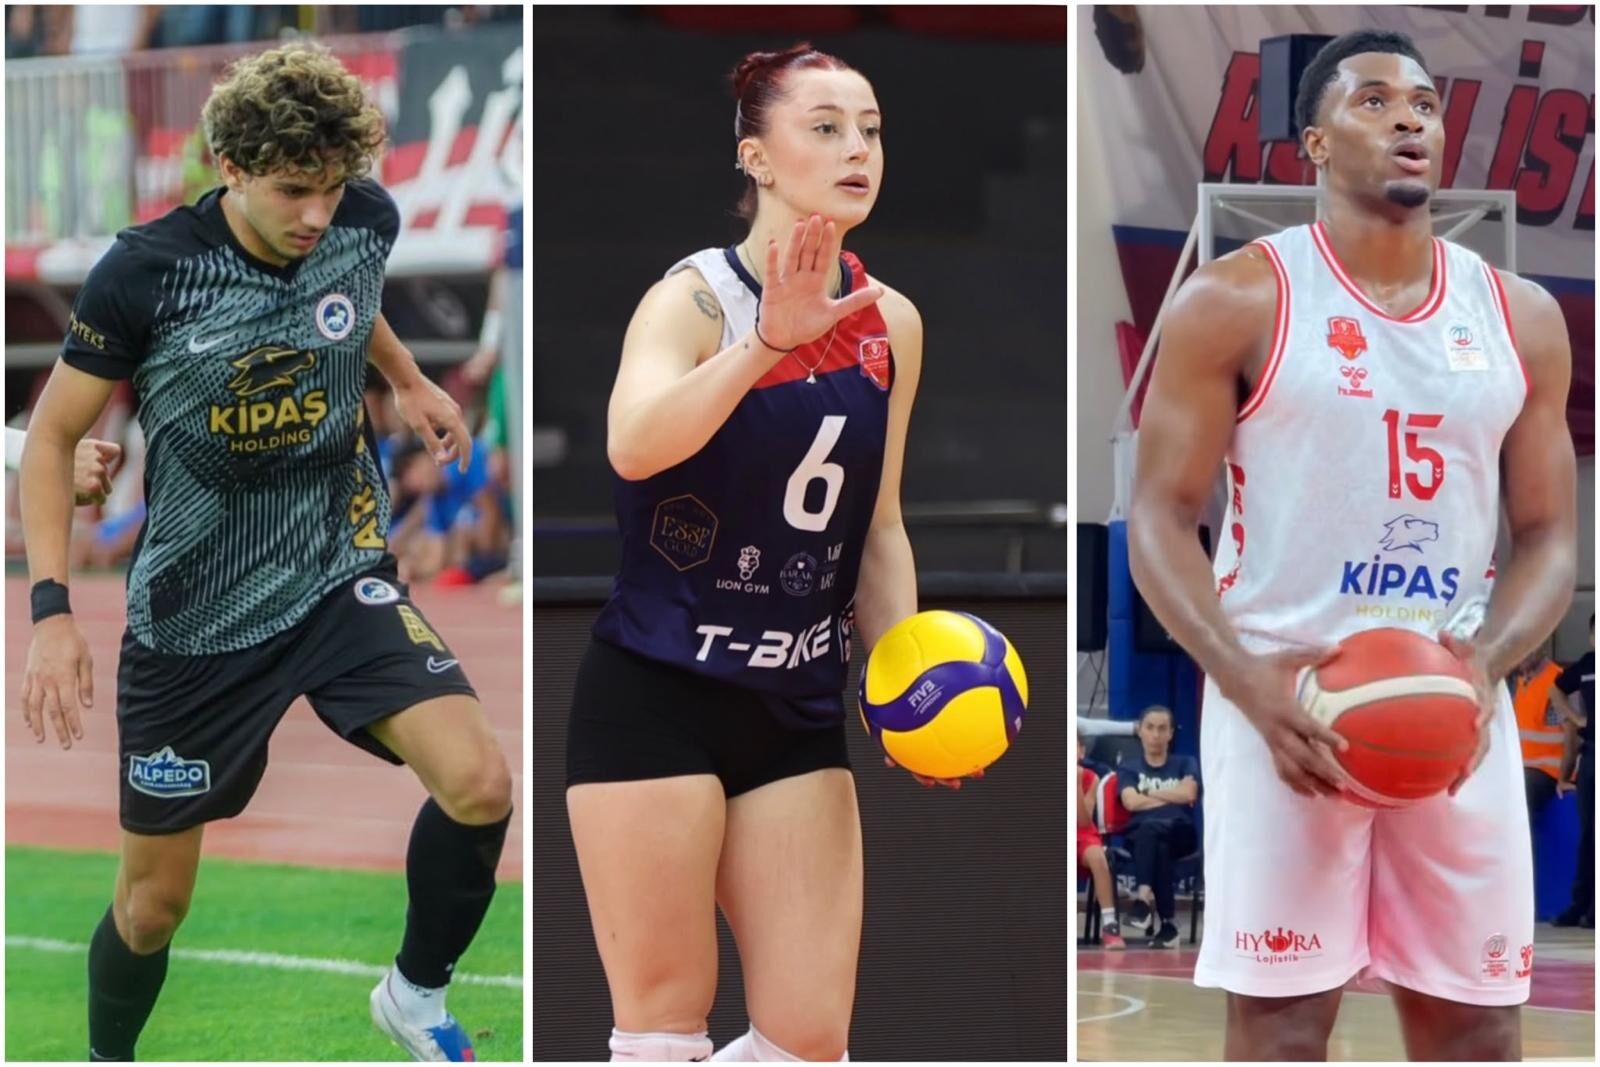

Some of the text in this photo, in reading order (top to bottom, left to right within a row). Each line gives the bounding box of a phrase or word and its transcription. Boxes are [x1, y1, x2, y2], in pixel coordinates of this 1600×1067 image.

[210, 390, 327, 434] KİPAŞ
[783, 415, 848, 532] 6
[1381, 409, 1445, 501] 15
[716, 579, 770, 595] LION GYM
[1339, 554, 1460, 607] KİPAŞ
[133, 762, 203, 782] ALPEDO
[1255, 954, 1299, 965] Lojistik
